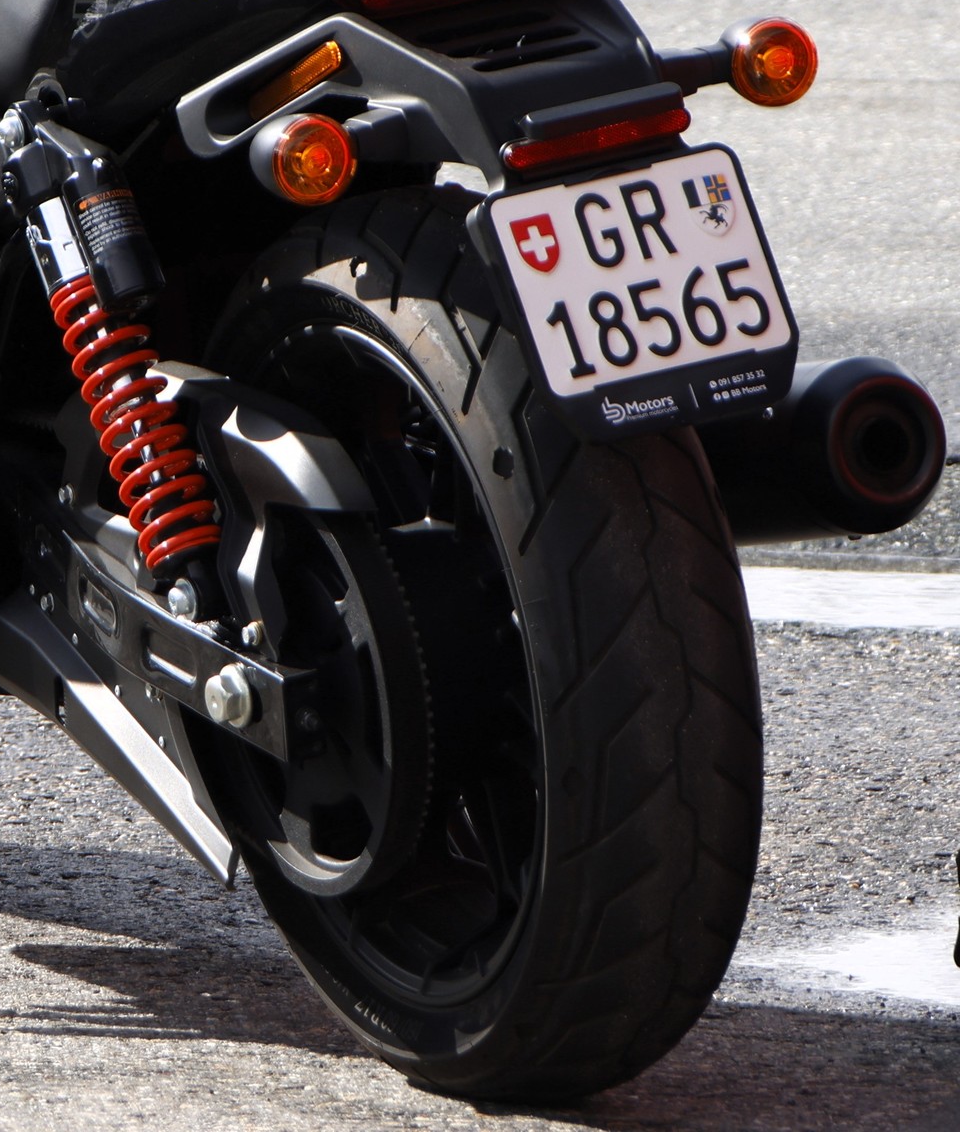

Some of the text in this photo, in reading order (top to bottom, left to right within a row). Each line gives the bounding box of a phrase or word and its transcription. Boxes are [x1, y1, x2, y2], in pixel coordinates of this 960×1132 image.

[574, 179, 678, 268] GR
[546, 258, 771, 379] 18565
[718, 369, 765, 386] 091 857 35 32
[741, 384, 767, 394] Motors
[625, 395, 674, 415] Motors
